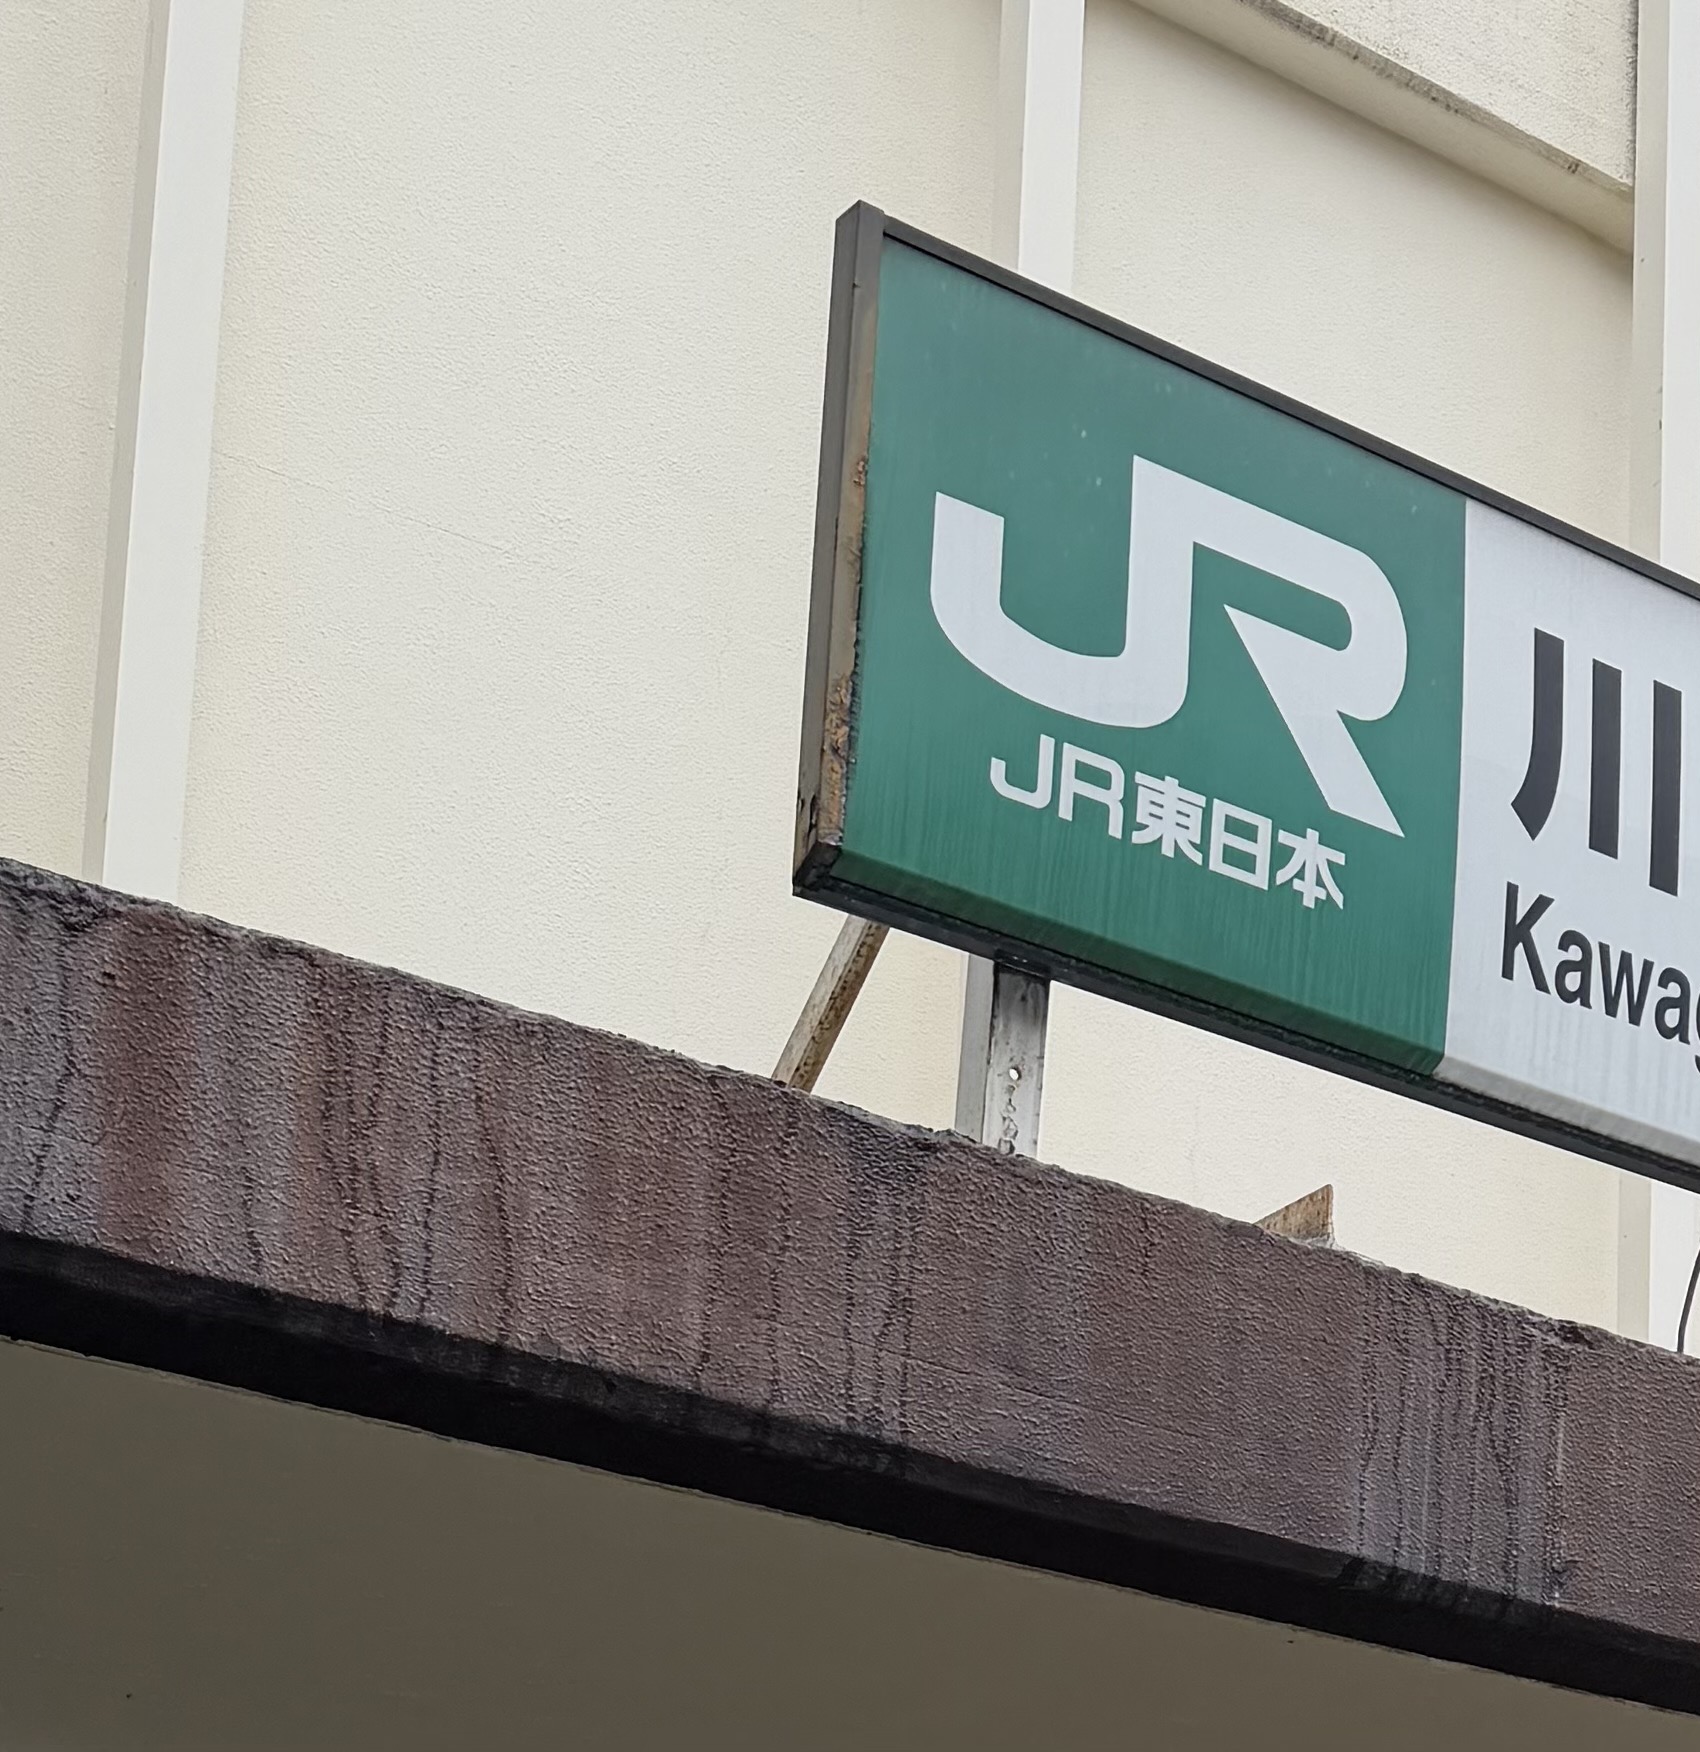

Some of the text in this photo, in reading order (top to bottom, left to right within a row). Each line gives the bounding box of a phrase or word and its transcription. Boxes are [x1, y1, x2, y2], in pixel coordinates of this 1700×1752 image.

[929, 453, 1408, 838] JR
[989, 733, 1346, 910] JR東日本
